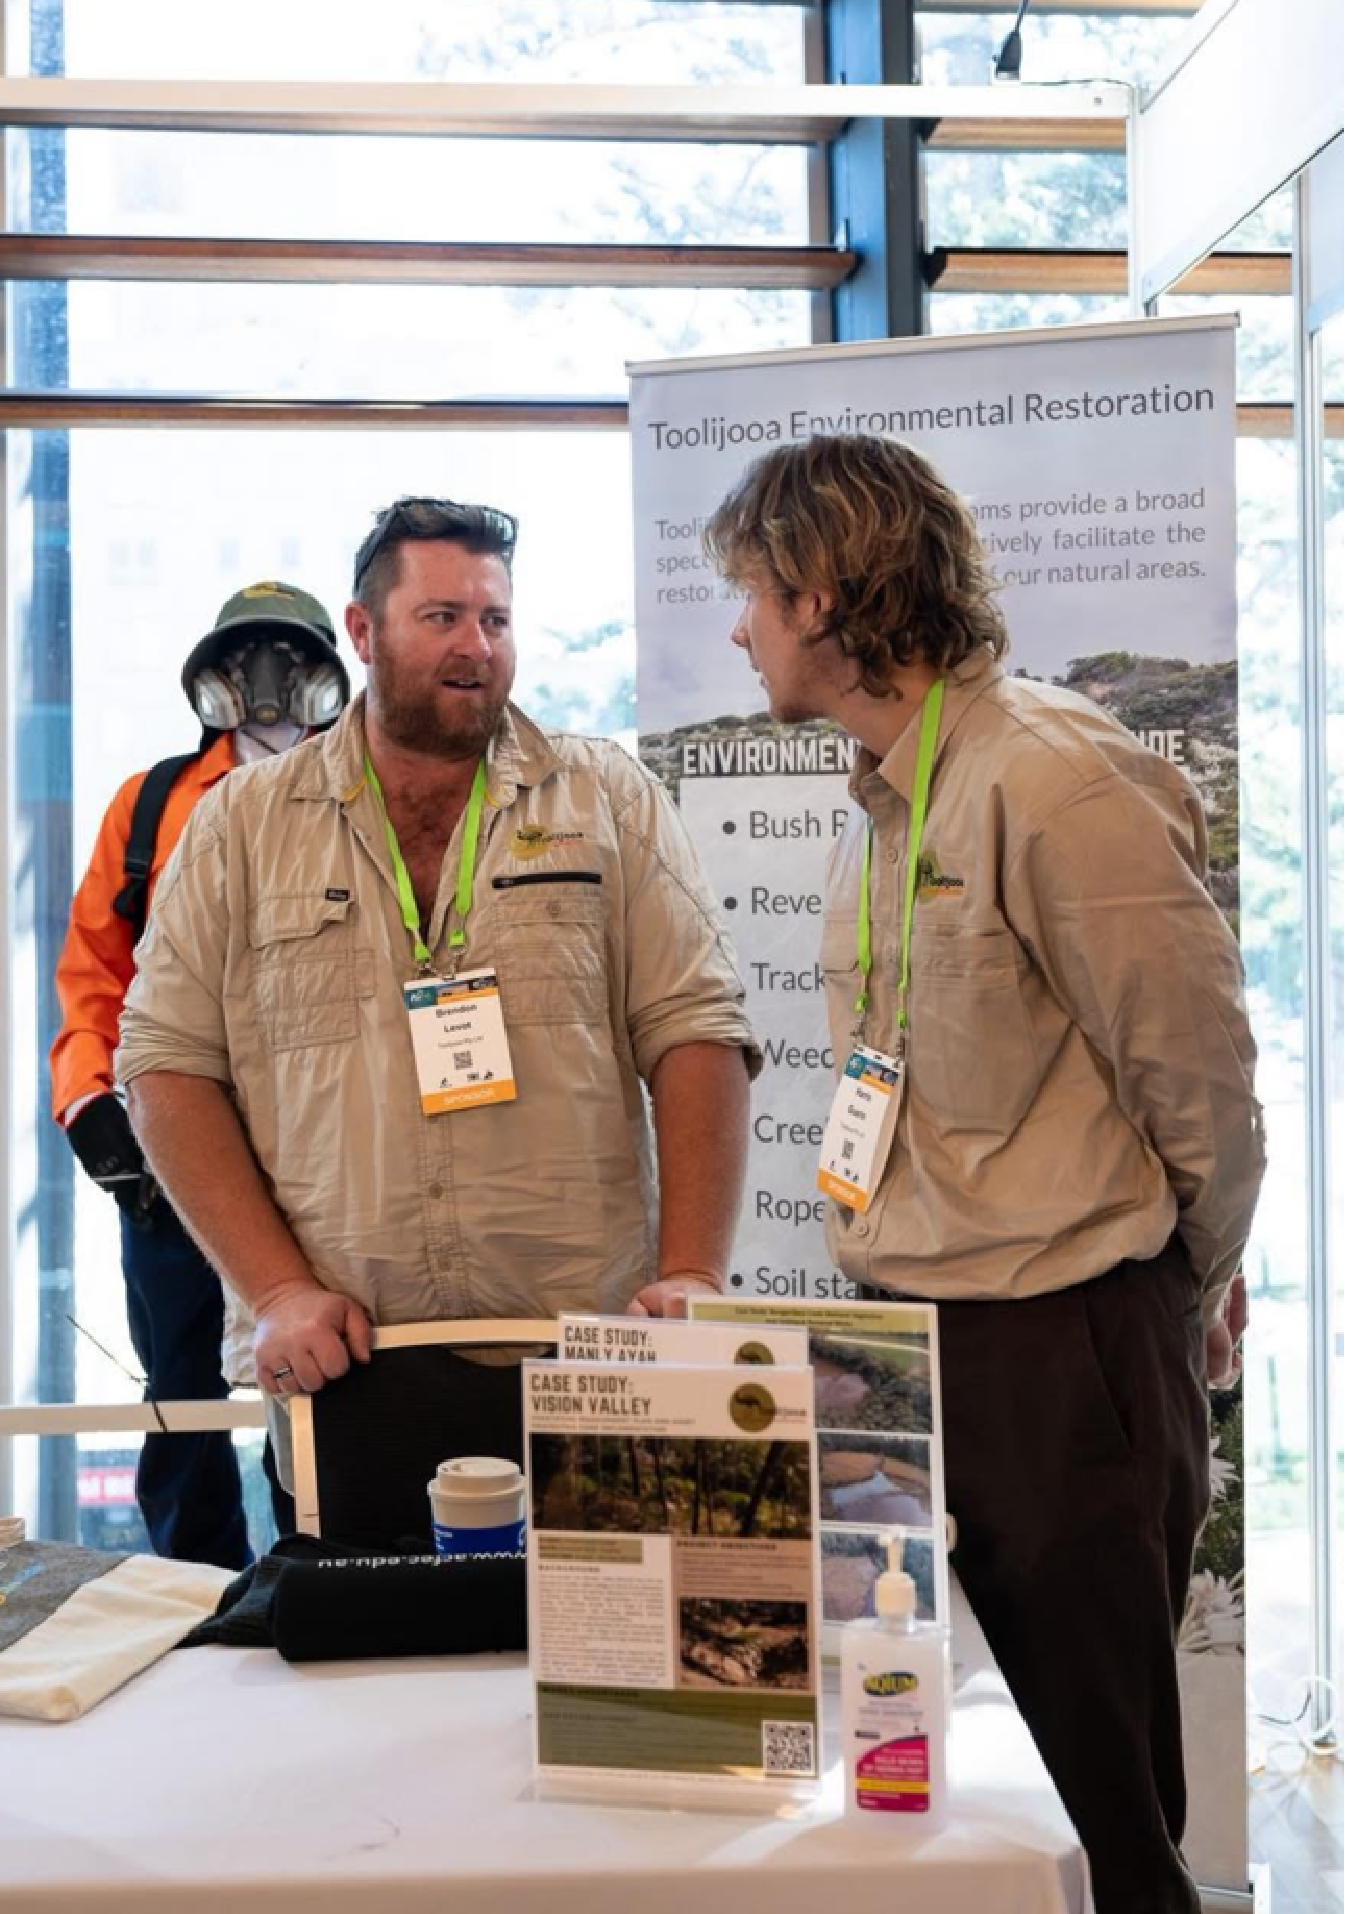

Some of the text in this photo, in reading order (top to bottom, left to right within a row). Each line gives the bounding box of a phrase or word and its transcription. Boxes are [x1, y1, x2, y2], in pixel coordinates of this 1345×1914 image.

[648, 384, 1215, 452] Toolijooa Environmental Restoration
[1019, 491, 1107, 523] provide
[1114, 498, 1128, 513] a
[1135, 487, 1206, 512] broad
[982, 530, 1043, 556] ively
[1053, 524, 1156, 552] facilitate
[1166, 523, 1206, 544] the
[1047, 560, 1131, 584] natural
[1136, 560, 1207, 580] areas.
[749, 808, 822, 839] Bush
[750, 885, 822, 916] Reve
[754, 1113, 830, 1145] Cree
[755, 1190, 826, 1228] Rope
[755, 1265, 807, 1297] Soil
[563, 1325, 653, 1348] CASE STUDY:
[530, 1373, 635, 1396] CASE STUDY:
[531, 1395, 652, 1416] VISION VALLEY
